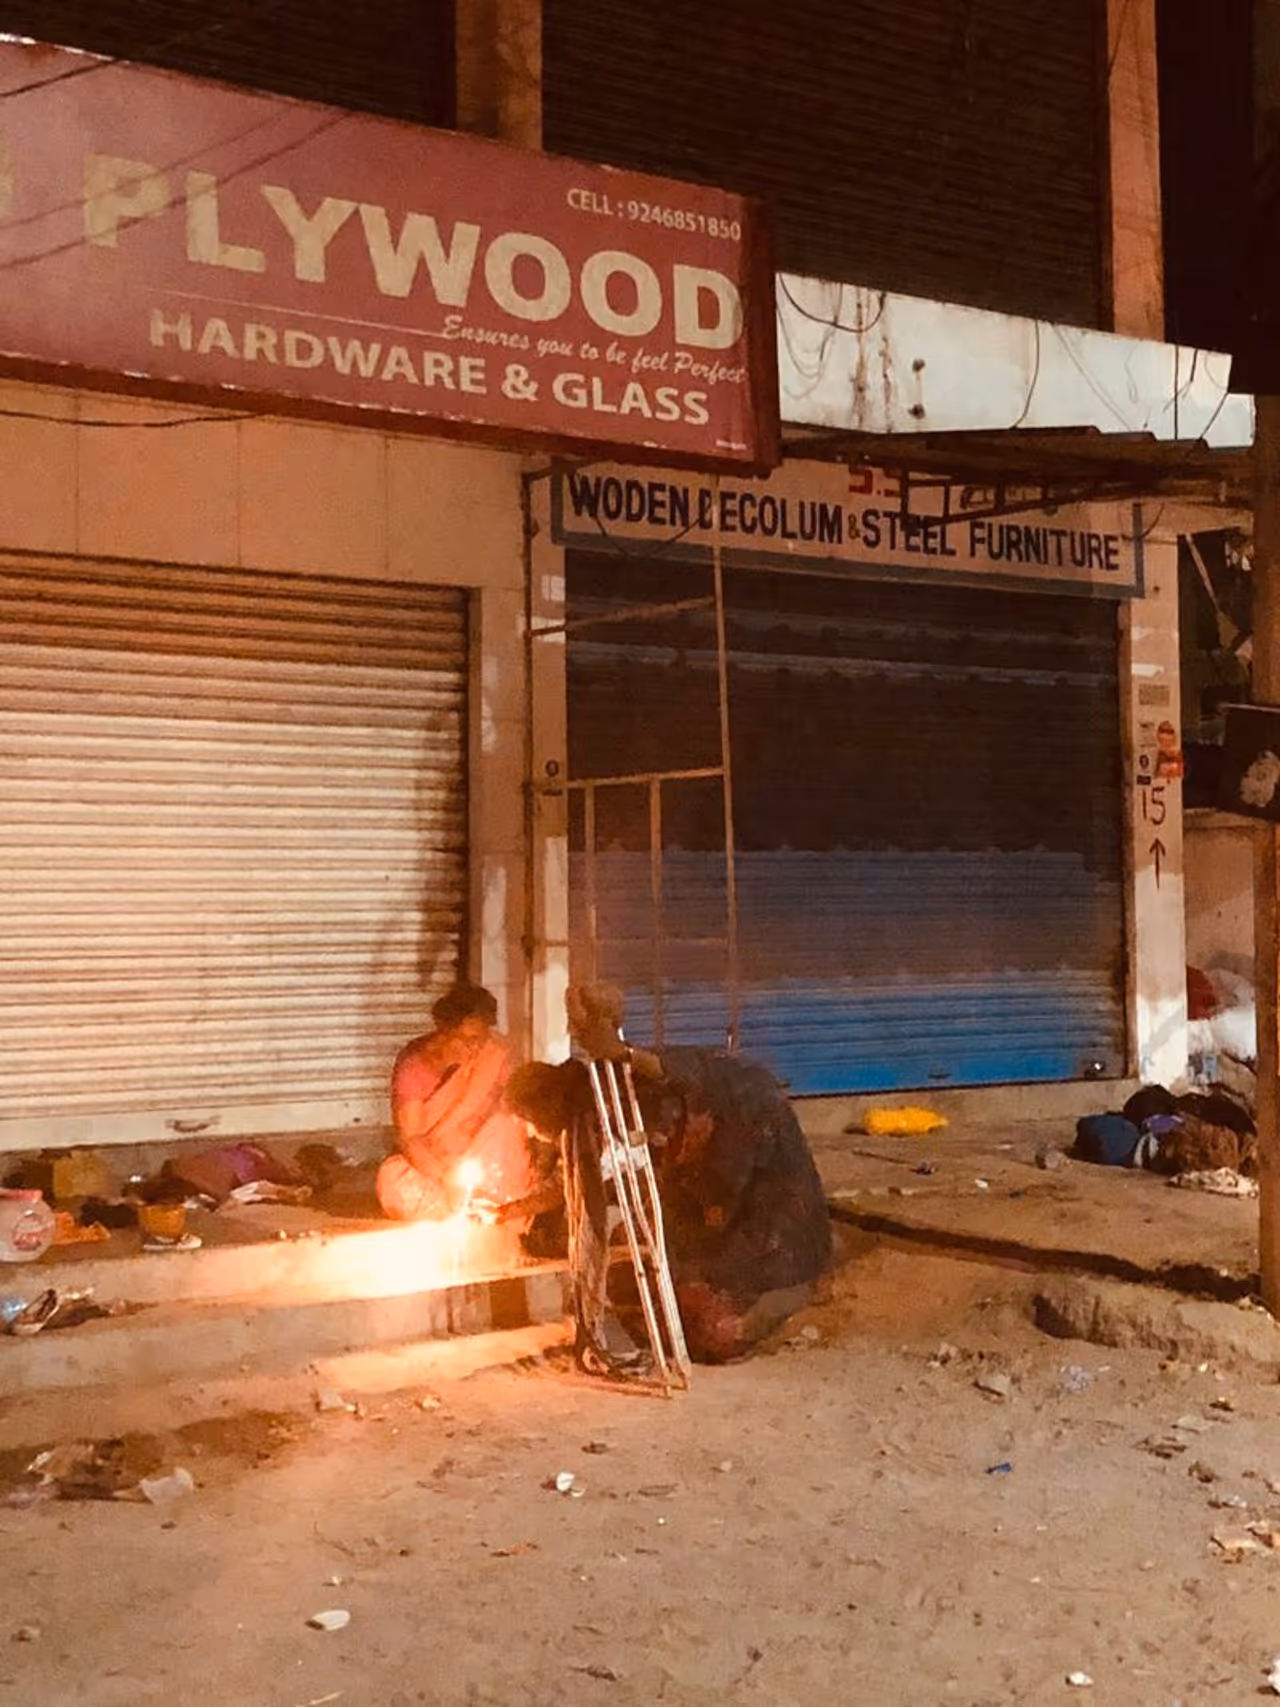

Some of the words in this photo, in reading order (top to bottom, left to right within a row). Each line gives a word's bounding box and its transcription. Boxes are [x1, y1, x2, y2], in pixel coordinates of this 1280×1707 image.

[83, 154, 743, 349] PLYWOOD
[150, 308, 487, 395] HARDWARE
[501, 363, 539, 401] &
[552, 372, 710, 426] GLASS
[442, 314, 530, 349] Ensures
[537, 337, 573, 357] you
[580, 341, 600, 360] to
[606, 341, 627, 364] be
[631, 348, 669, 374] feel
[674, 351, 747, 386] Perfect
[569, 473, 690, 527] WODEN
[698, 487, 843, 545] DECOLUM
[862, 508, 957, 557] STEEL
[969, 518, 1120, 571] FURNITURE
[1142, 786, 1167, 826] 15
